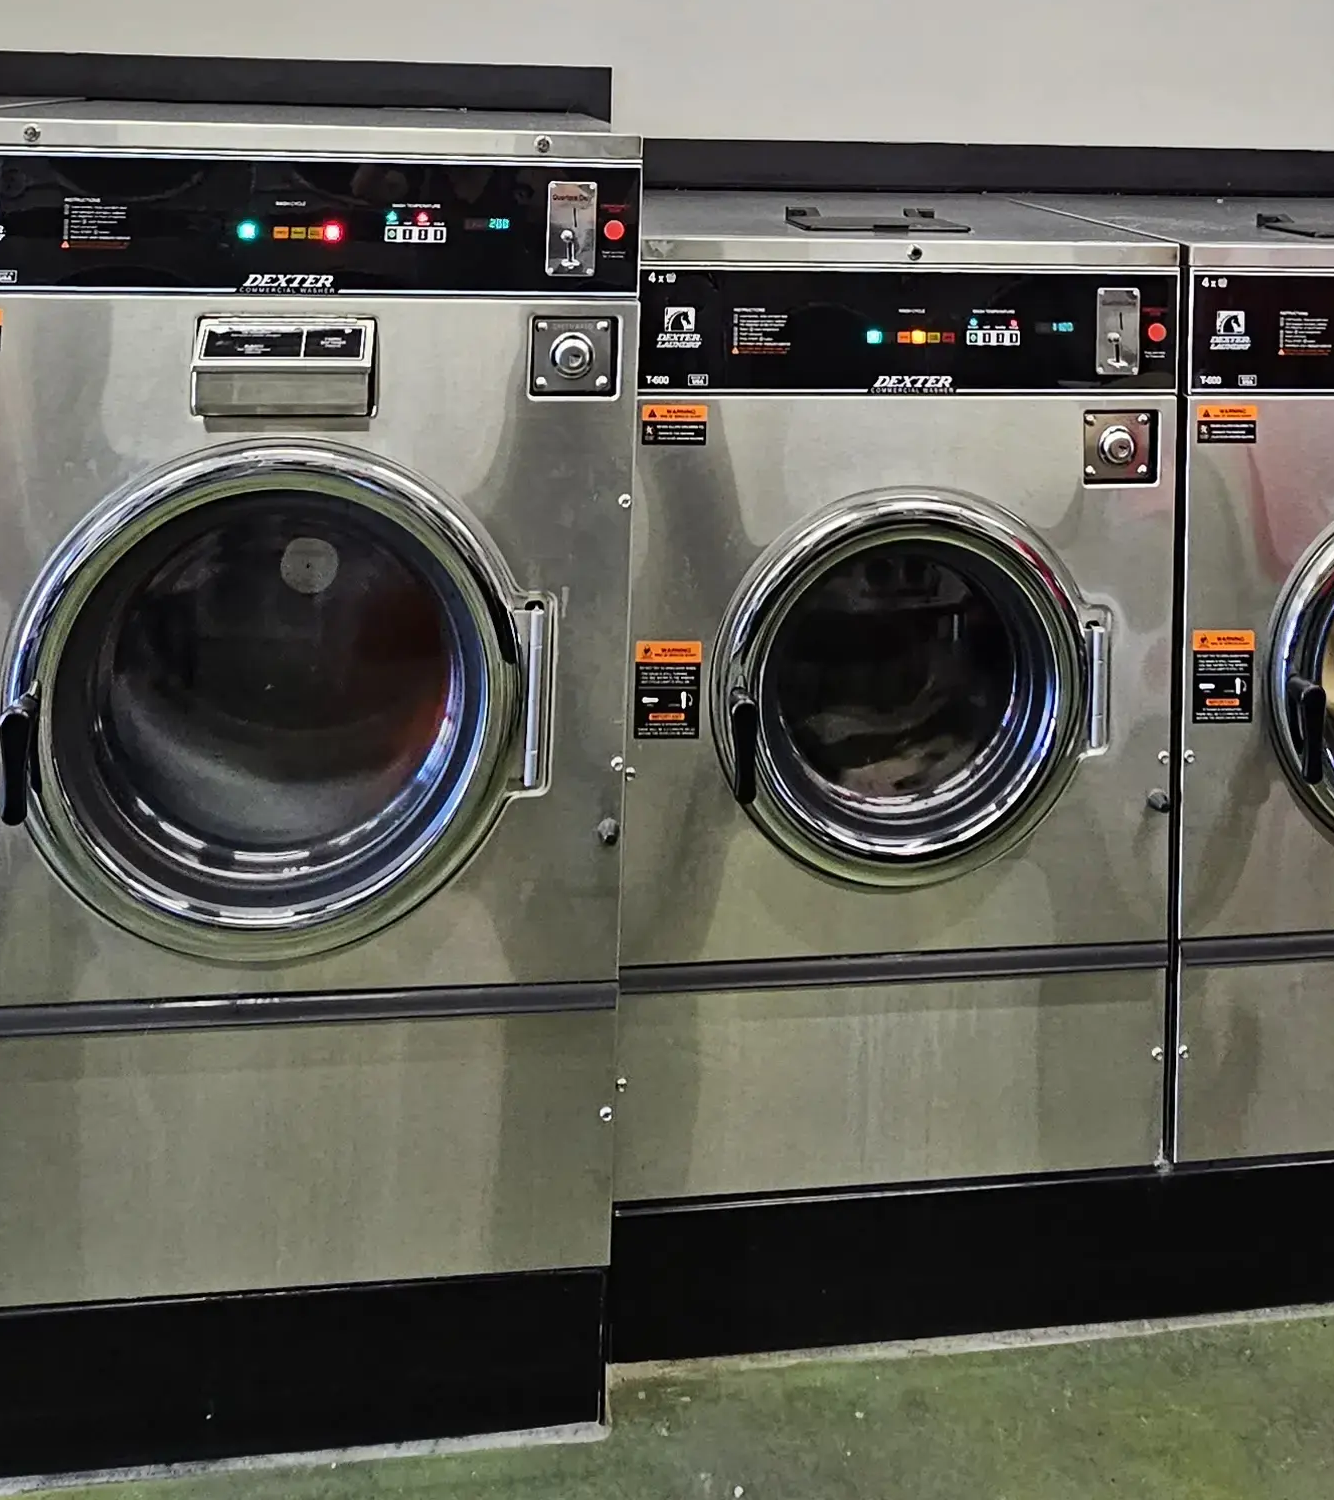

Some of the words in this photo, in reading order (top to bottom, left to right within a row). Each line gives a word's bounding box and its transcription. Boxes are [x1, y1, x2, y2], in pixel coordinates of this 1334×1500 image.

[243, 274, 334, 287] DEXTER
[648, 272, 656, 283] 4
[1201, 277, 1210, 287] 4
[873, 376, 953, 387] DEXTER
